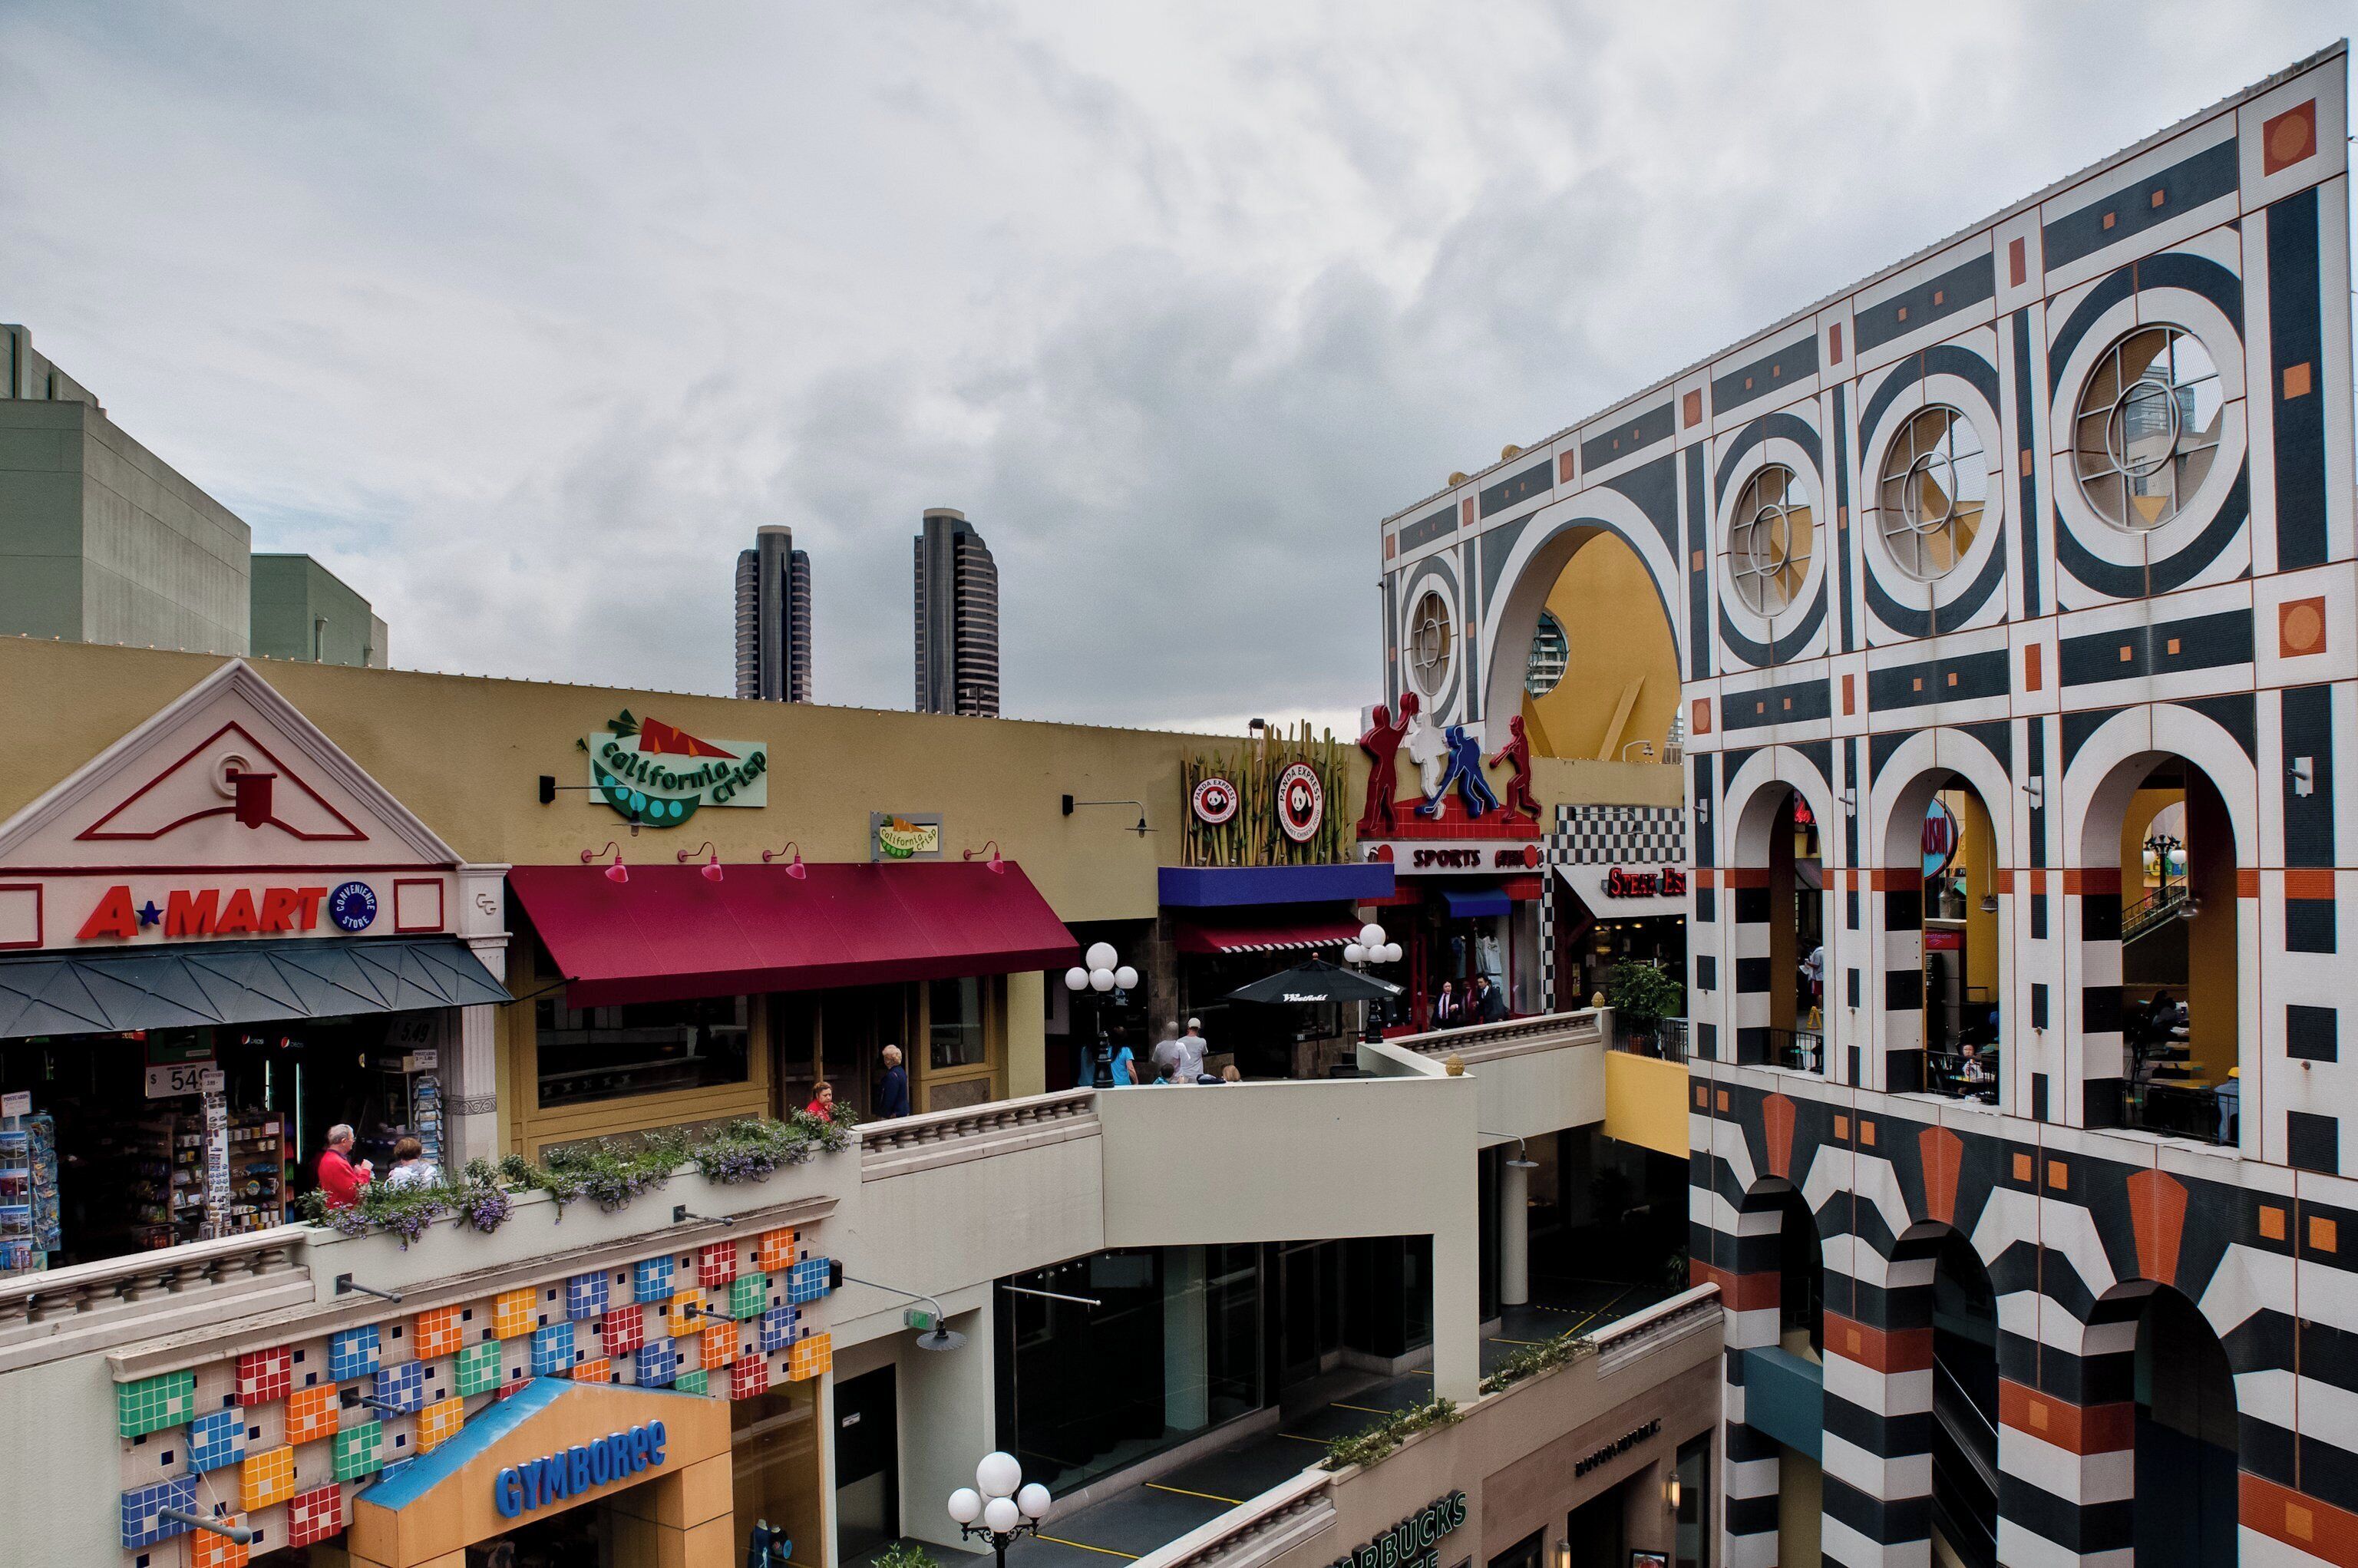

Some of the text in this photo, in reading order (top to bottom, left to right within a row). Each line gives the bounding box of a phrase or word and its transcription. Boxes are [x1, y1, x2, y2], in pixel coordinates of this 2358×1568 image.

[713, 751, 766, 803] crisp
[1280, 767, 1321, 801] PANDA EXPRESS
[1195, 780, 1236, 800] PANDA EXPRESS
[1280, 810, 1296, 836] GOURMET
[1296, 828, 1313, 838] CHINESE
[916, 828, 936, 850] crisp
[1414, 850, 1481, 868] SPORTS
[1609, 867, 1658, 897] STEAK
[336, 884, 375, 912] CONVENIENCE
[164, 887, 328, 936] MART
[342, 915, 370, 929] STORE
[1283, 993, 1328, 1002] Westfield
[150, 1074, 157, 1085] $
